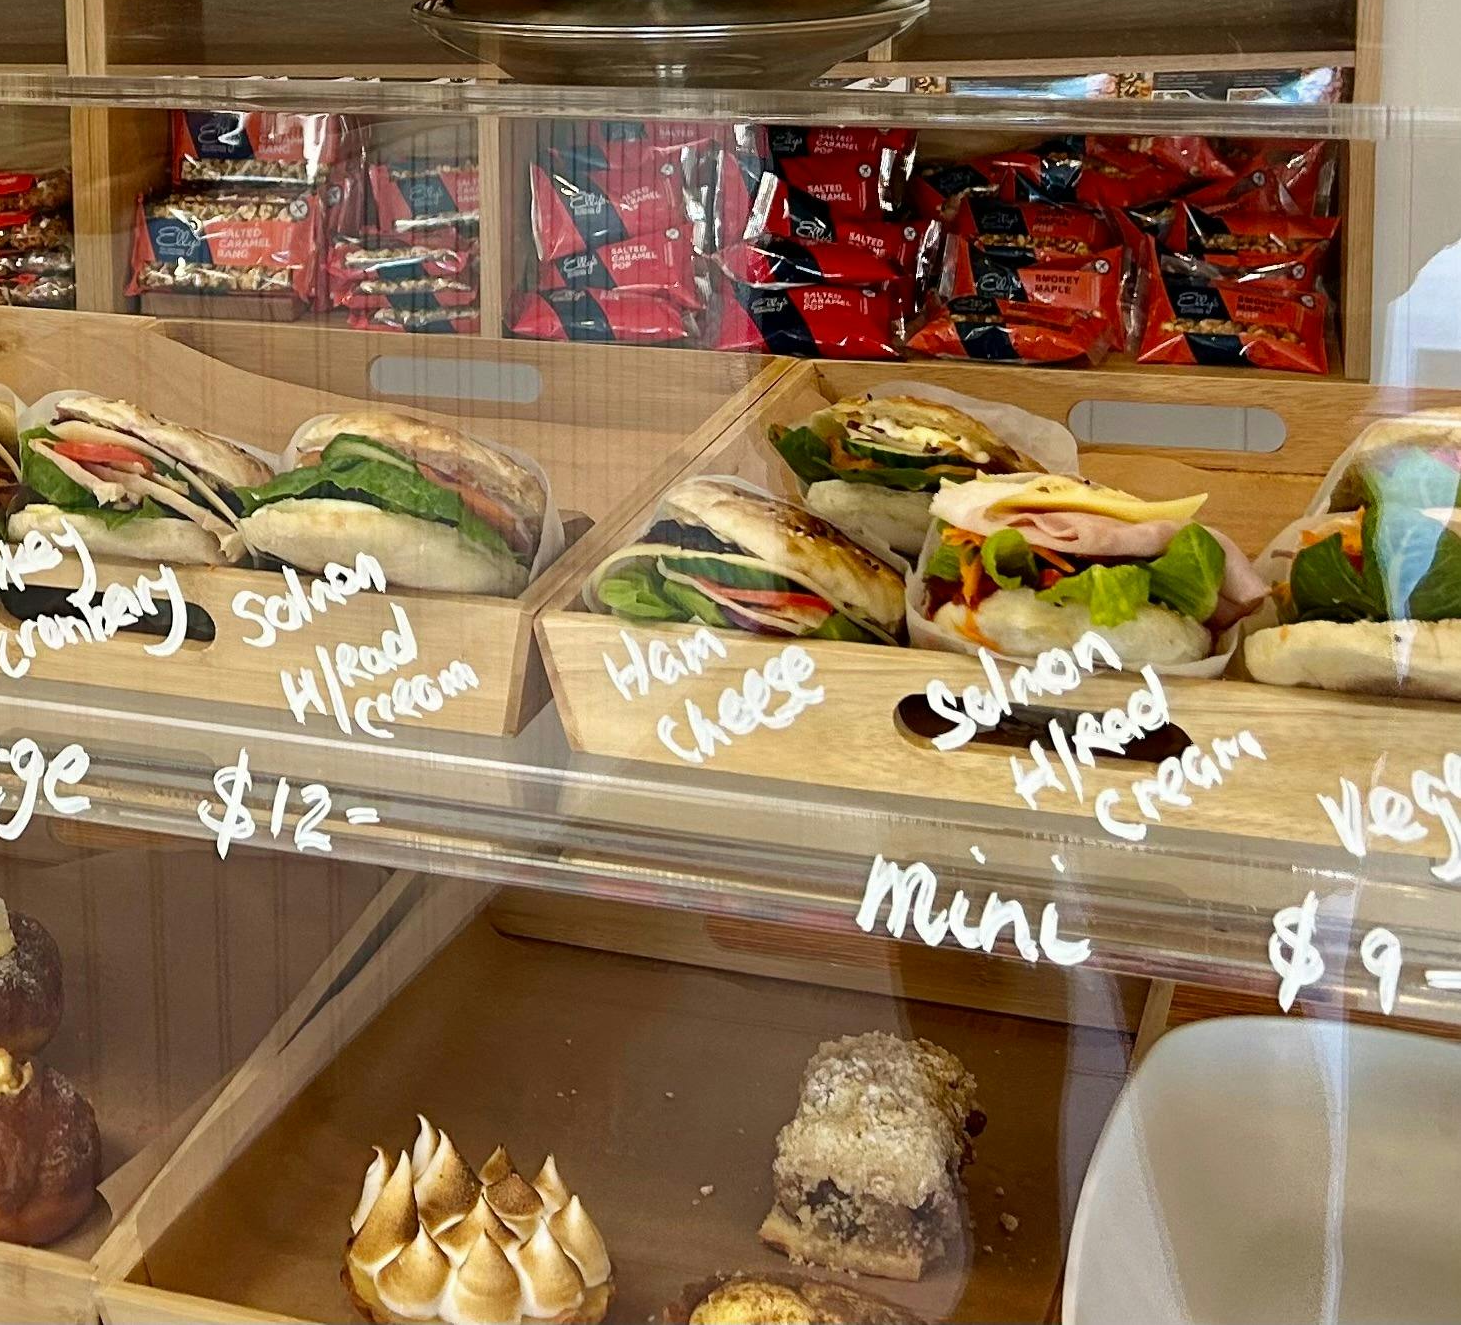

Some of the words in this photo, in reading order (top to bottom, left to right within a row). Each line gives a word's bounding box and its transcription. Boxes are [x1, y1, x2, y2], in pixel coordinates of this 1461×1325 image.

[807, 184, 843, 193] SALTED
[811, 192, 853, 202] ARAMEL
[219, 238, 271, 249] CARAMEL
[848, 231, 885, 248] SALTED
[217, 249, 249, 259] BANG
[610, 244, 648, 256] SALTED
[611, 252, 658, 263] CARAMEL
[1035, 275, 1080, 285] SMOKEY
[1034, 284, 1072, 295] MAPLE
[601, 629, 728, 702] Ham
[924, 630, 1124, 752] Salmon
